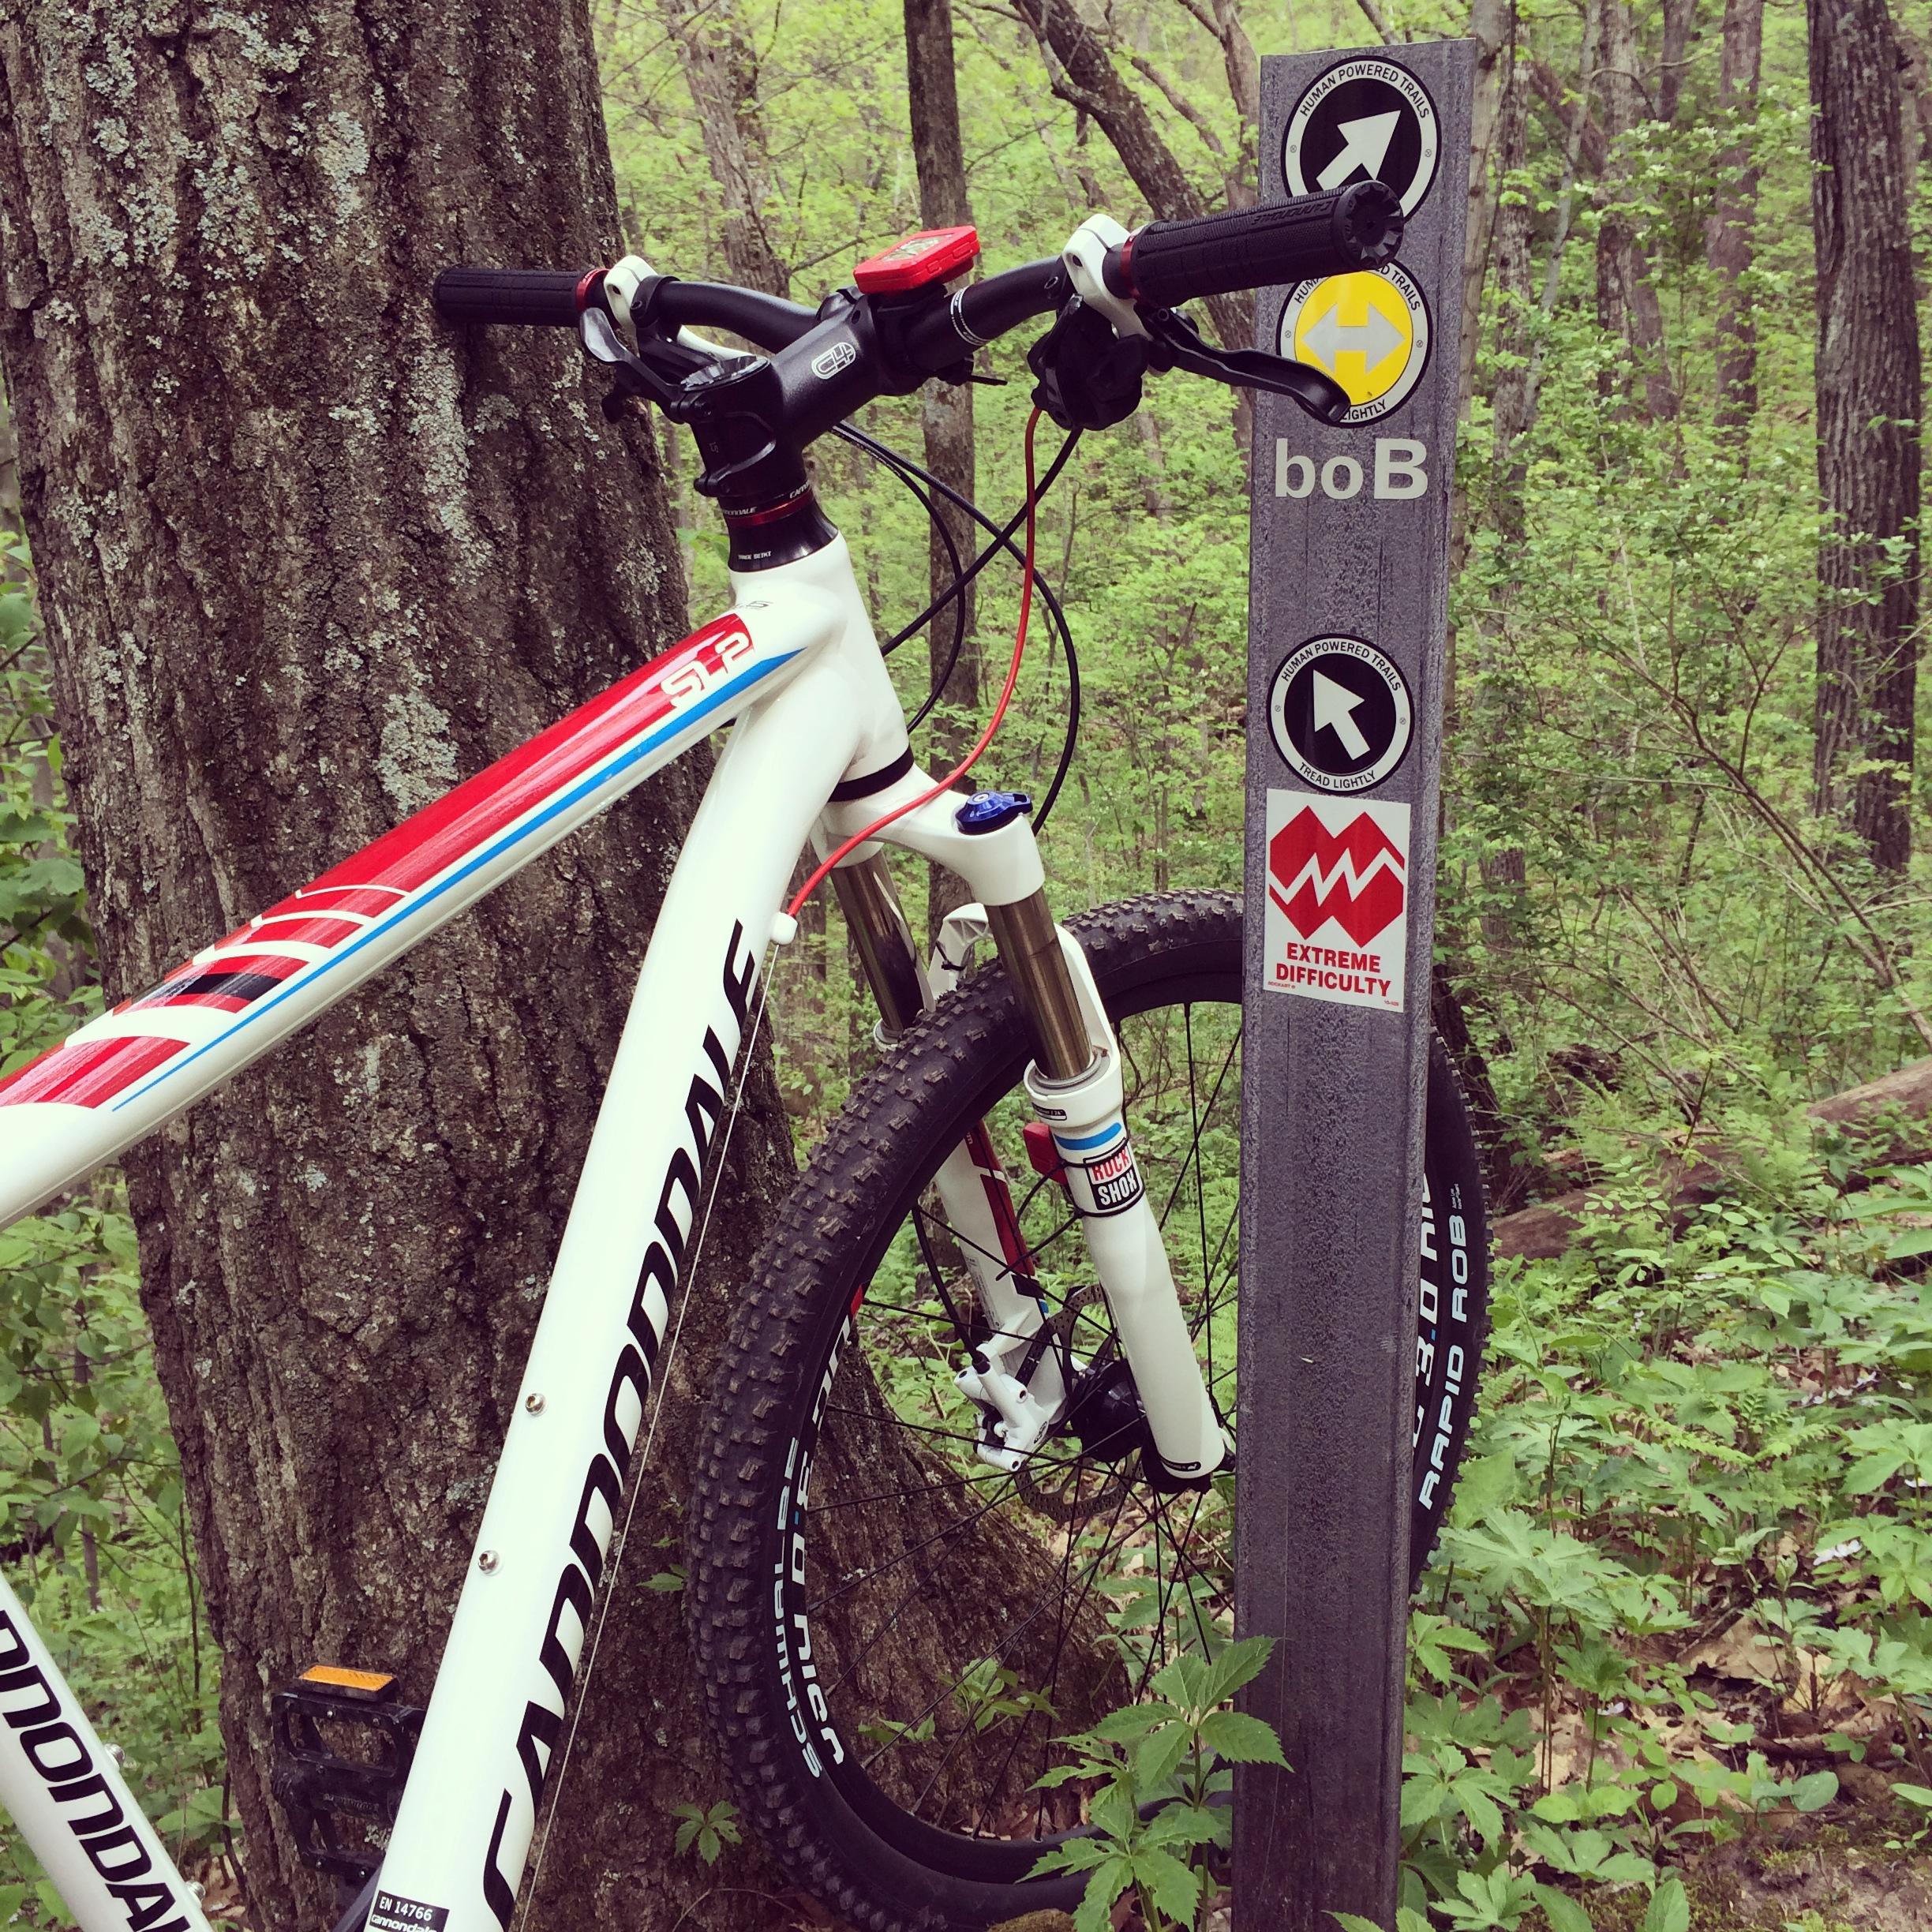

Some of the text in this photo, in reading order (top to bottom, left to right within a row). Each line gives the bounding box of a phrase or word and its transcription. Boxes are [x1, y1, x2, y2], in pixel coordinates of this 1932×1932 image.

[1300, 64, 1429, 118] HUMAN POWERED TRAILS
[1294, 270, 1421, 311] HUM TRAILS
[1275, 438, 1428, 500] boB
[1281, 641, 1401, 691] HUMAN POWERED TRAILS
[1299, 762, 1376, 788] TREAD LIGHTLY
[1286, 942, 1381, 973] EXTREME
[1276, 963, 1391, 997] DIFFICULTY
[1091, 1148, 1131, 1181] ROCK
[1098, 1169, 1137, 1206] SHOX
[1419, 1215, 1468, 1511] RAPID ROB
[774, 1436, 822, 1778] SCHWALBE
[379, 1896, 433, 1922] EN 14766
